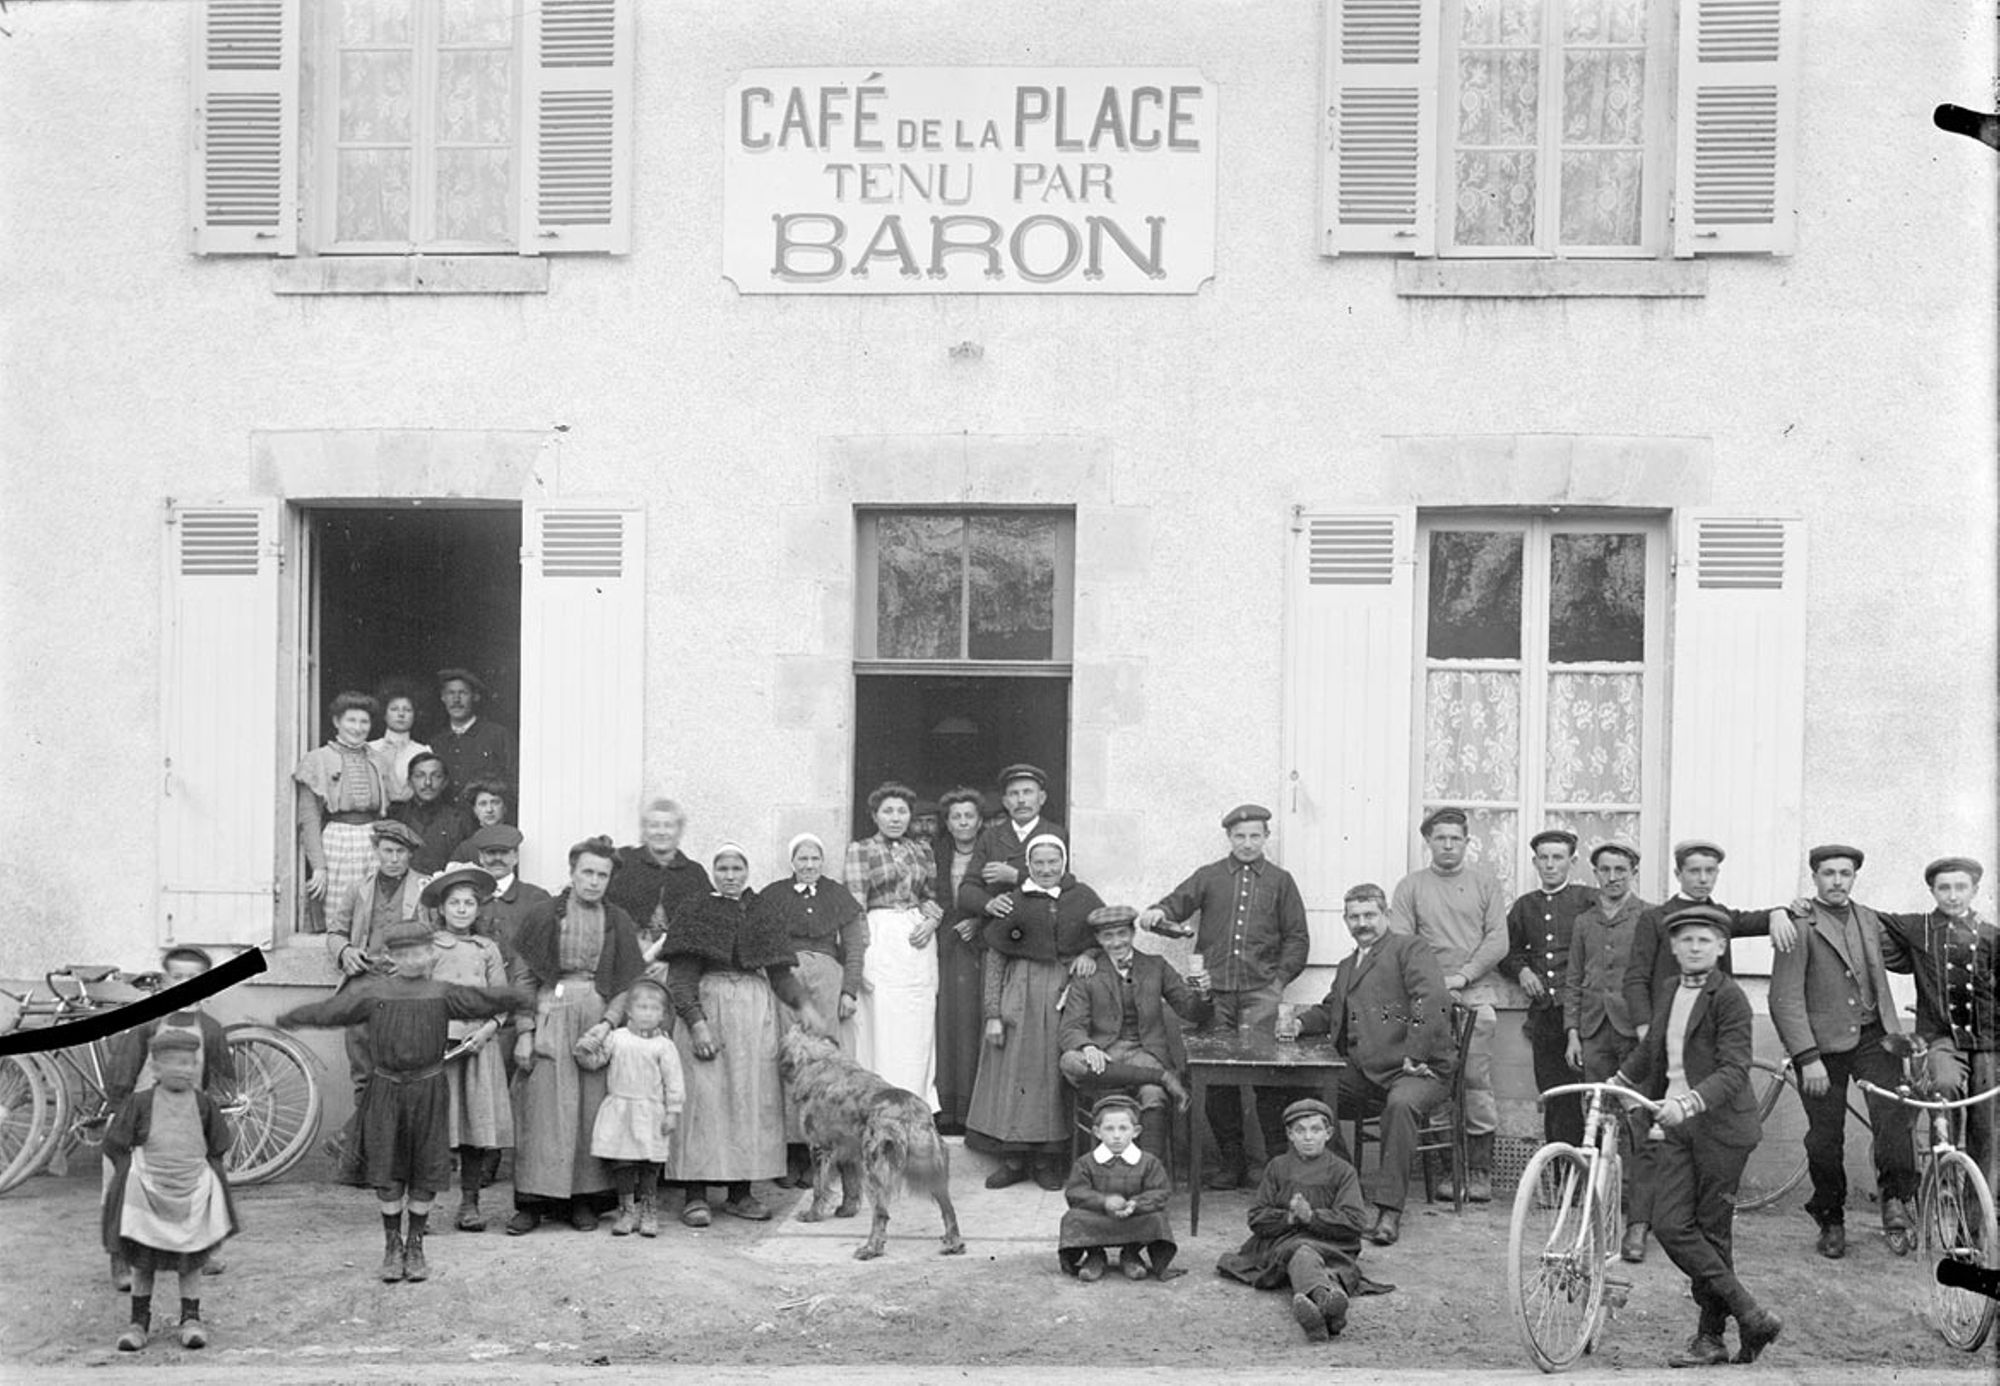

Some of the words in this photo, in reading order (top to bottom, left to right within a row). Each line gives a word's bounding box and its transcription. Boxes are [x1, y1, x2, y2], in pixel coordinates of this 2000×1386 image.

[740, 72, 887, 150] CAFÉ
[898, 119, 942, 149] DE
[955, 119, 1001, 149] LA
[1014, 86, 1202, 151] PLACE
[823, 163, 973, 205] TENU
[1012, 163, 1116, 203] PAR
[770, 212, 1168, 283] BARON
